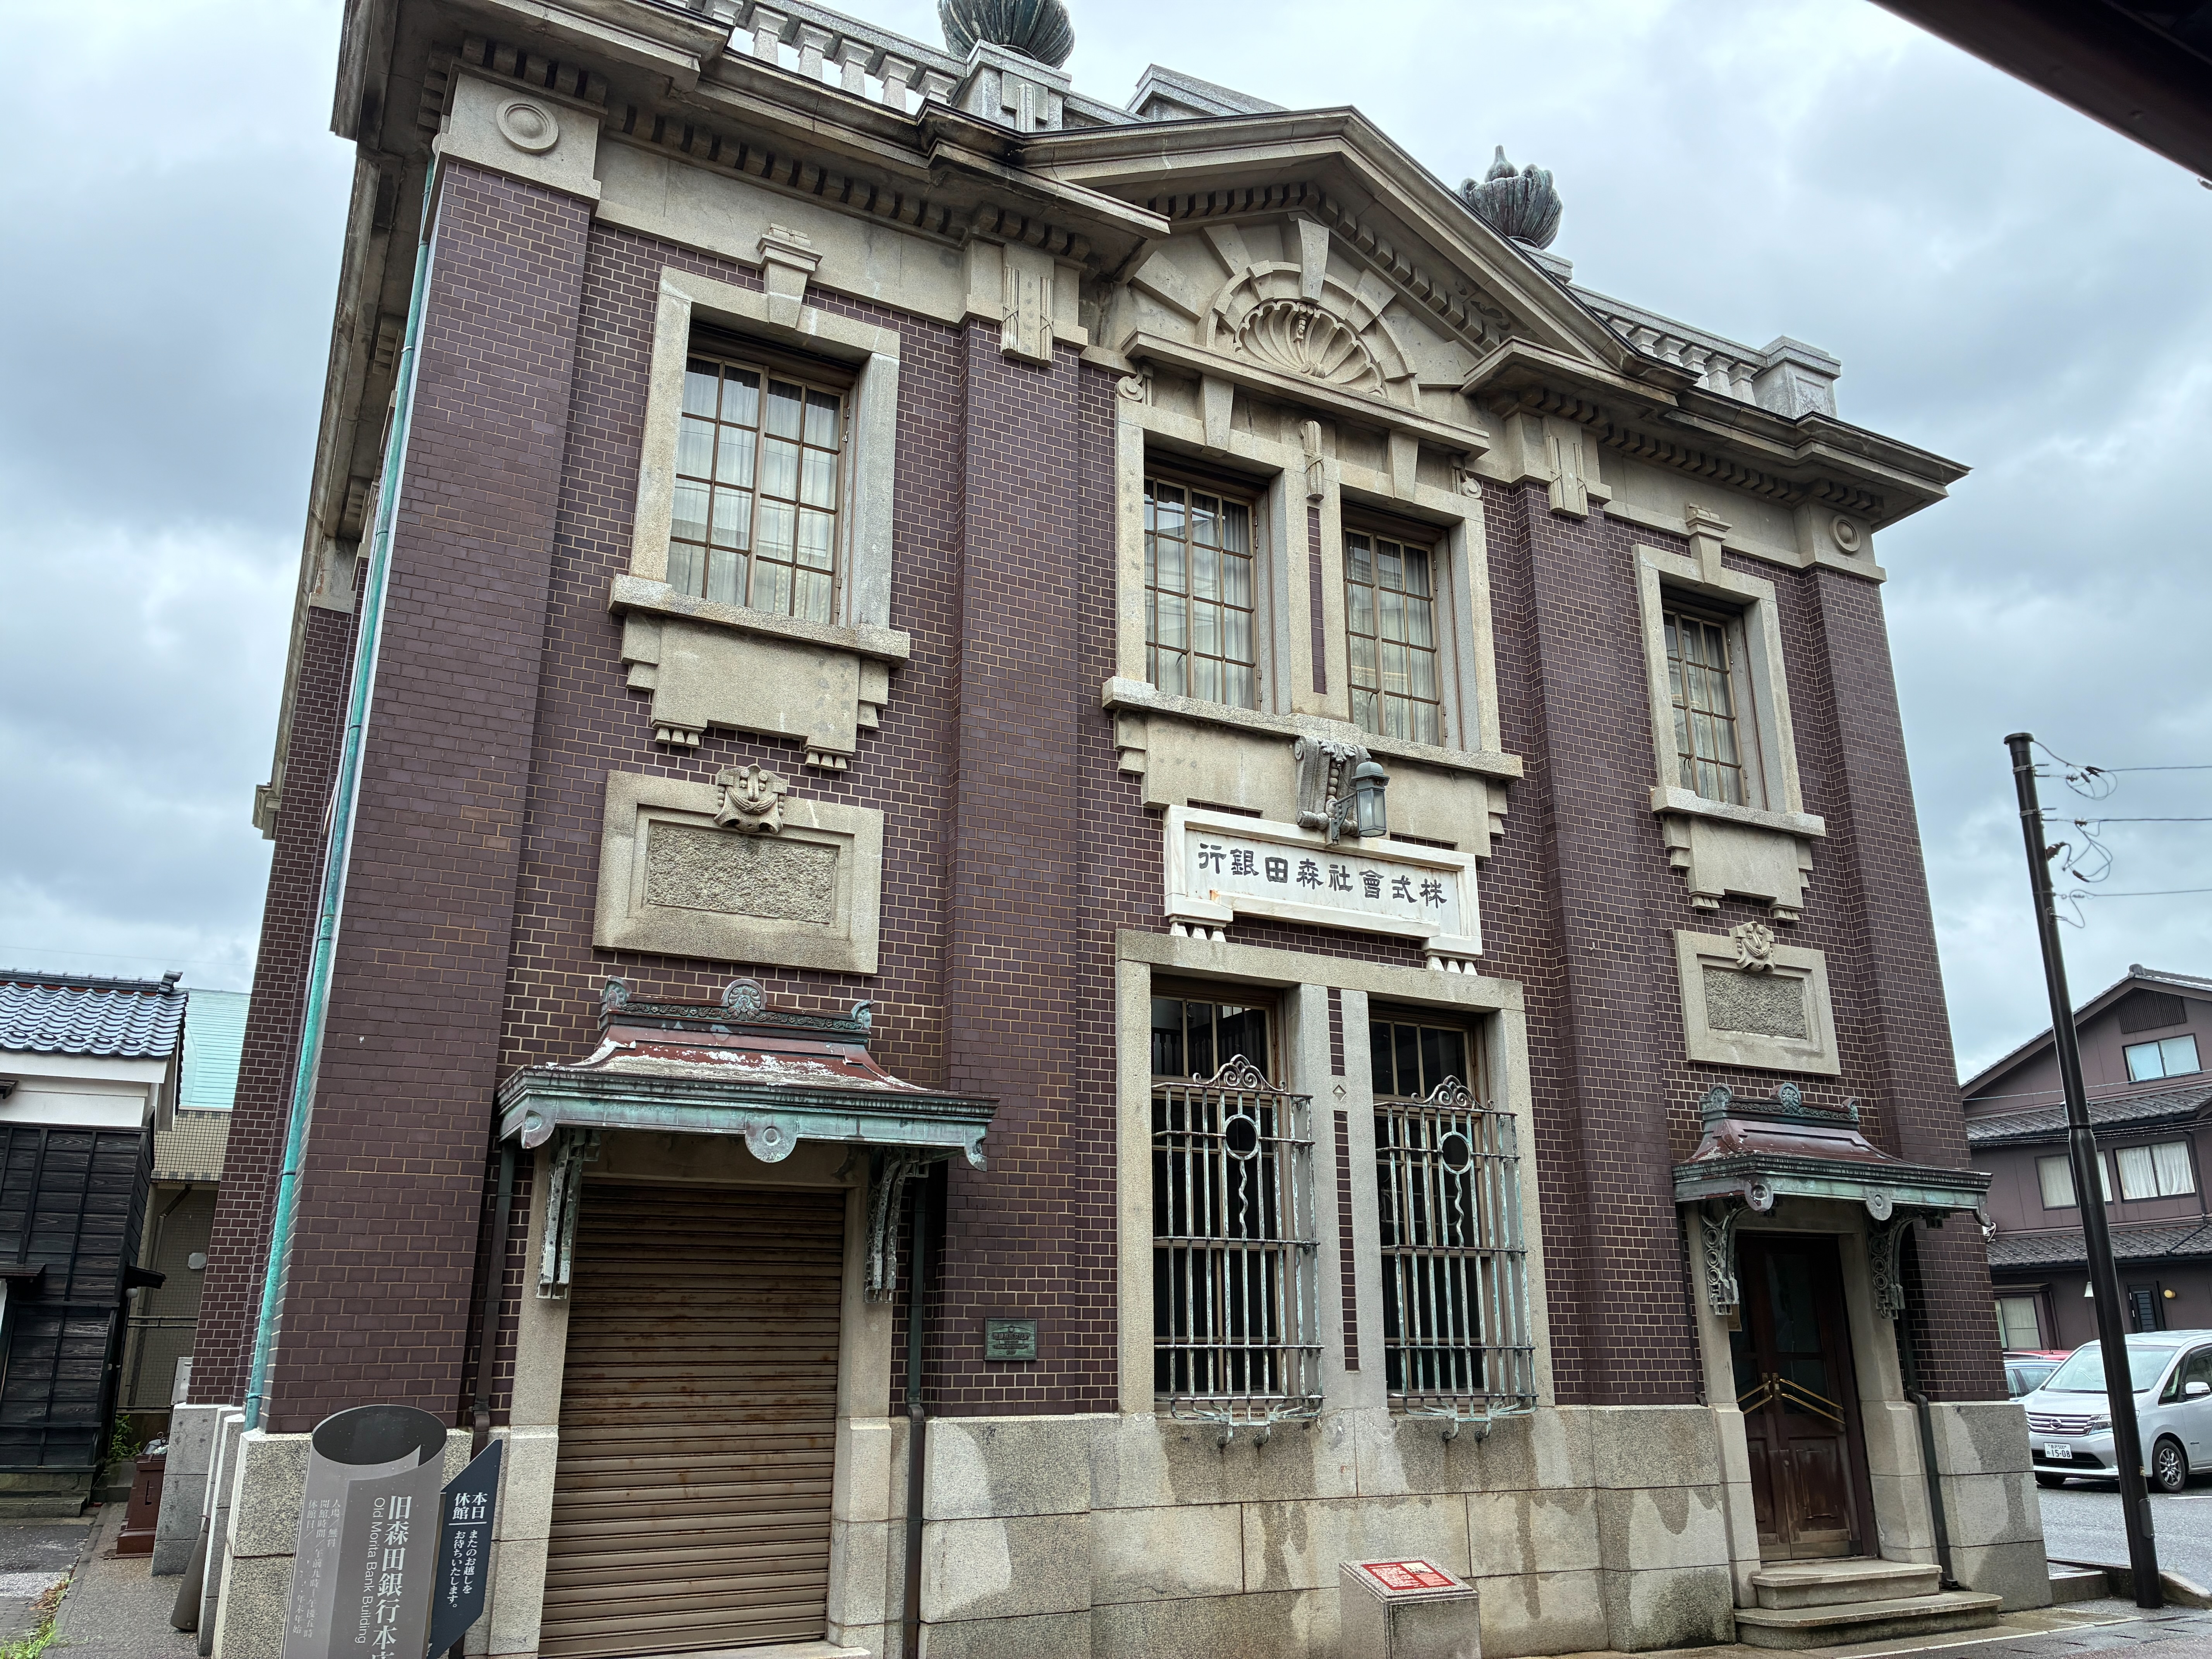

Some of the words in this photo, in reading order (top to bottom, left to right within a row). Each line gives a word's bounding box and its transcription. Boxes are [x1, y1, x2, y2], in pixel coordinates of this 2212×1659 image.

[373, 1498, 385, 1518] Old
[452, 1492, 471, 1520] 休館
[471, 1492, 488, 1520] 本日
[367, 1522, 383, 1558] Morita
[363, 1561, 377, 1592] Bank
[447, 1531, 466, 1607] お待ちいたします。
[462, 1530, 478, 1594] またのお越しを
[355, 1596, 373, 1644] Building
